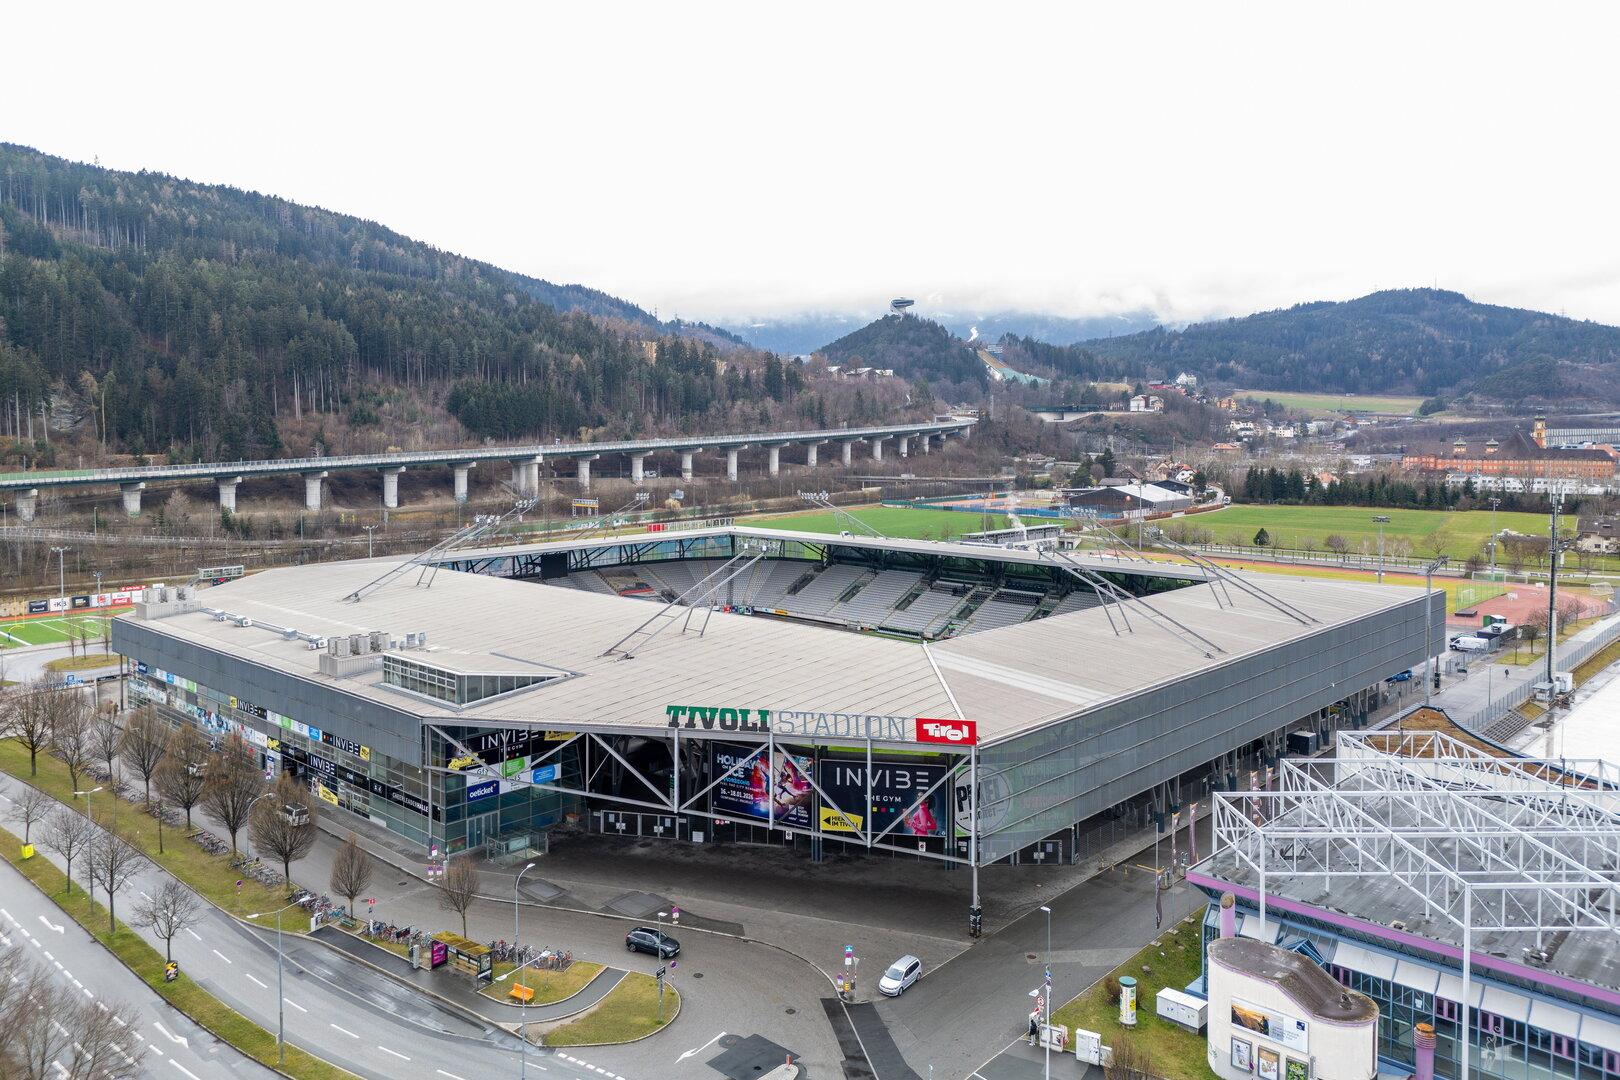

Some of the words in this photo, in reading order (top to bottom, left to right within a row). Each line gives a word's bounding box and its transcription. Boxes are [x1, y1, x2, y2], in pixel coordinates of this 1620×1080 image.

[237, 699, 258, 716] INVIBE
[666, 705, 770, 733] TIVOLI
[778, 711, 908, 740] STADION
[923, 723, 969, 741] Tirol
[332, 735, 359, 756] INVIBE
[480, 730, 539, 750] INVIBE
[310, 755, 335, 775] INVIBE
[836, 767, 929, 790] INVIBE
[469, 785, 494, 798] oeticket
[882, 795, 902, 803] GYM
